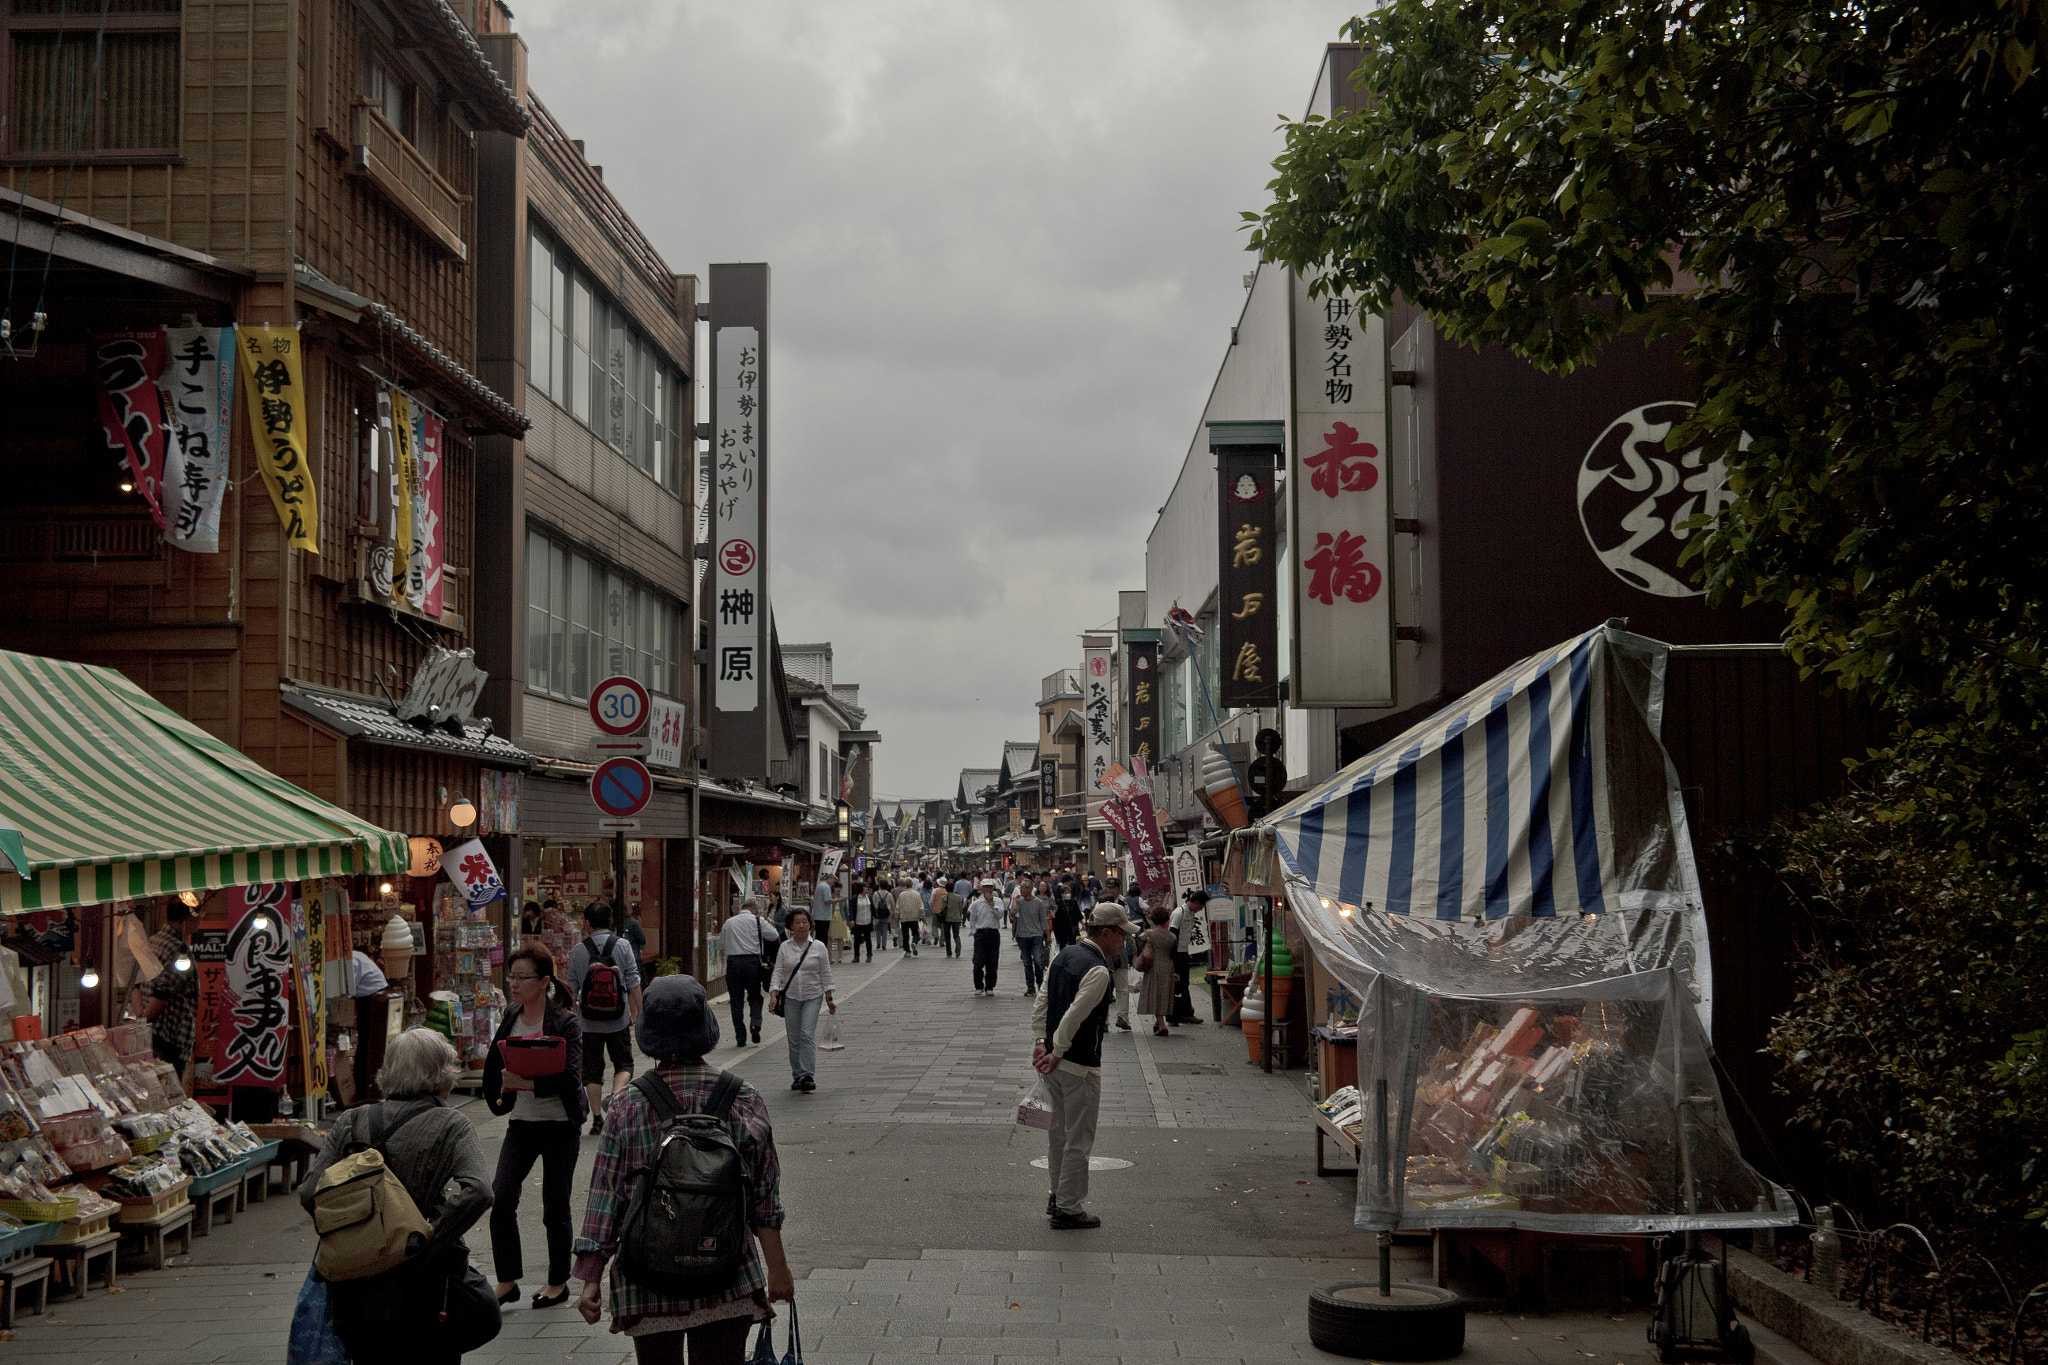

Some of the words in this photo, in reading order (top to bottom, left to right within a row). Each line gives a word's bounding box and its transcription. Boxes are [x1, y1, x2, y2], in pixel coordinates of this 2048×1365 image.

[246, 337, 291, 354] 名物
[1323, 297, 1352, 404] 伊勢名物
[174, 336, 215, 539] 手こね寿司
[254, 359, 306, 539] 伊勢うどん
[736, 346, 757, 492] お伊勢まいり
[719, 429, 739, 521] おみやげ
[1304, 422, 1381, 605] 赤福
[720, 589, 753, 681] 榊原
[1232, 523, 1263, 683] 岩戸屋
[603, 693, 636, 719] 30
[661, 706, 680, 748] 赤福
[1087, 682, 1112, 745] お食事処
[424, 842, 439, 871] 奉祝
[459, 853, 493, 884] 氷
[202, 967, 220, 1039] ザ・モルツ
